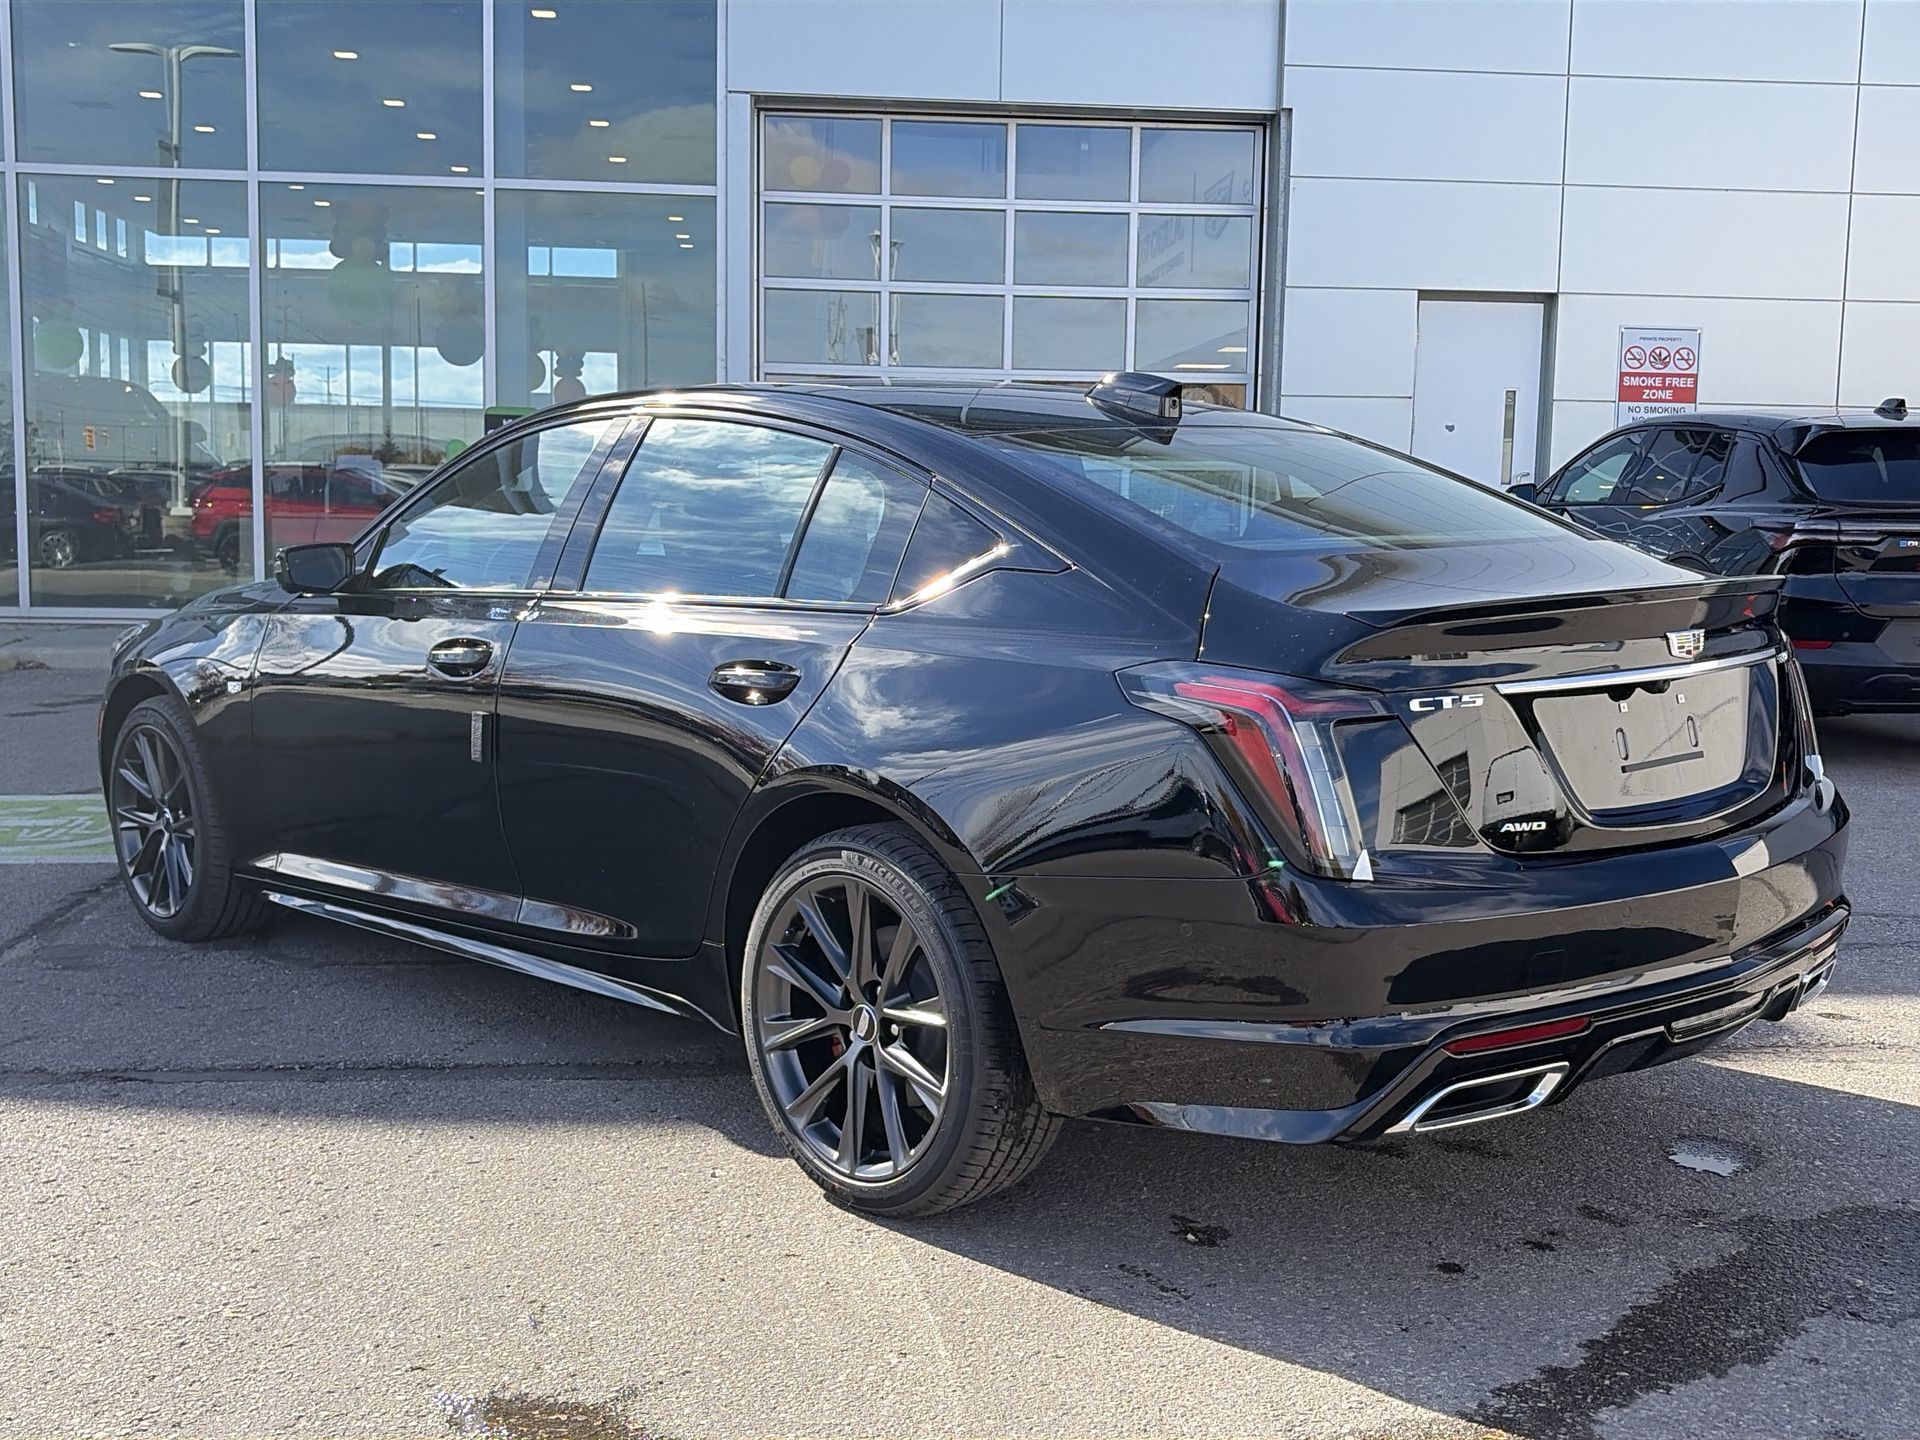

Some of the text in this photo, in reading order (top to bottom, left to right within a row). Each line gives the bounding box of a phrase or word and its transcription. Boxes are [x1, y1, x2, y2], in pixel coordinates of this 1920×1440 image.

[1623, 376, 1694, 387] SMOKE FREE
[1642, 389, 1673, 399] ZONE
[1643, 406, 1686, 414] SMOKING
[1409, 694, 1484, 712] CT5
[1500, 821, 1547, 832] AWD
[861, 858, 921, 914] MICHELIN
